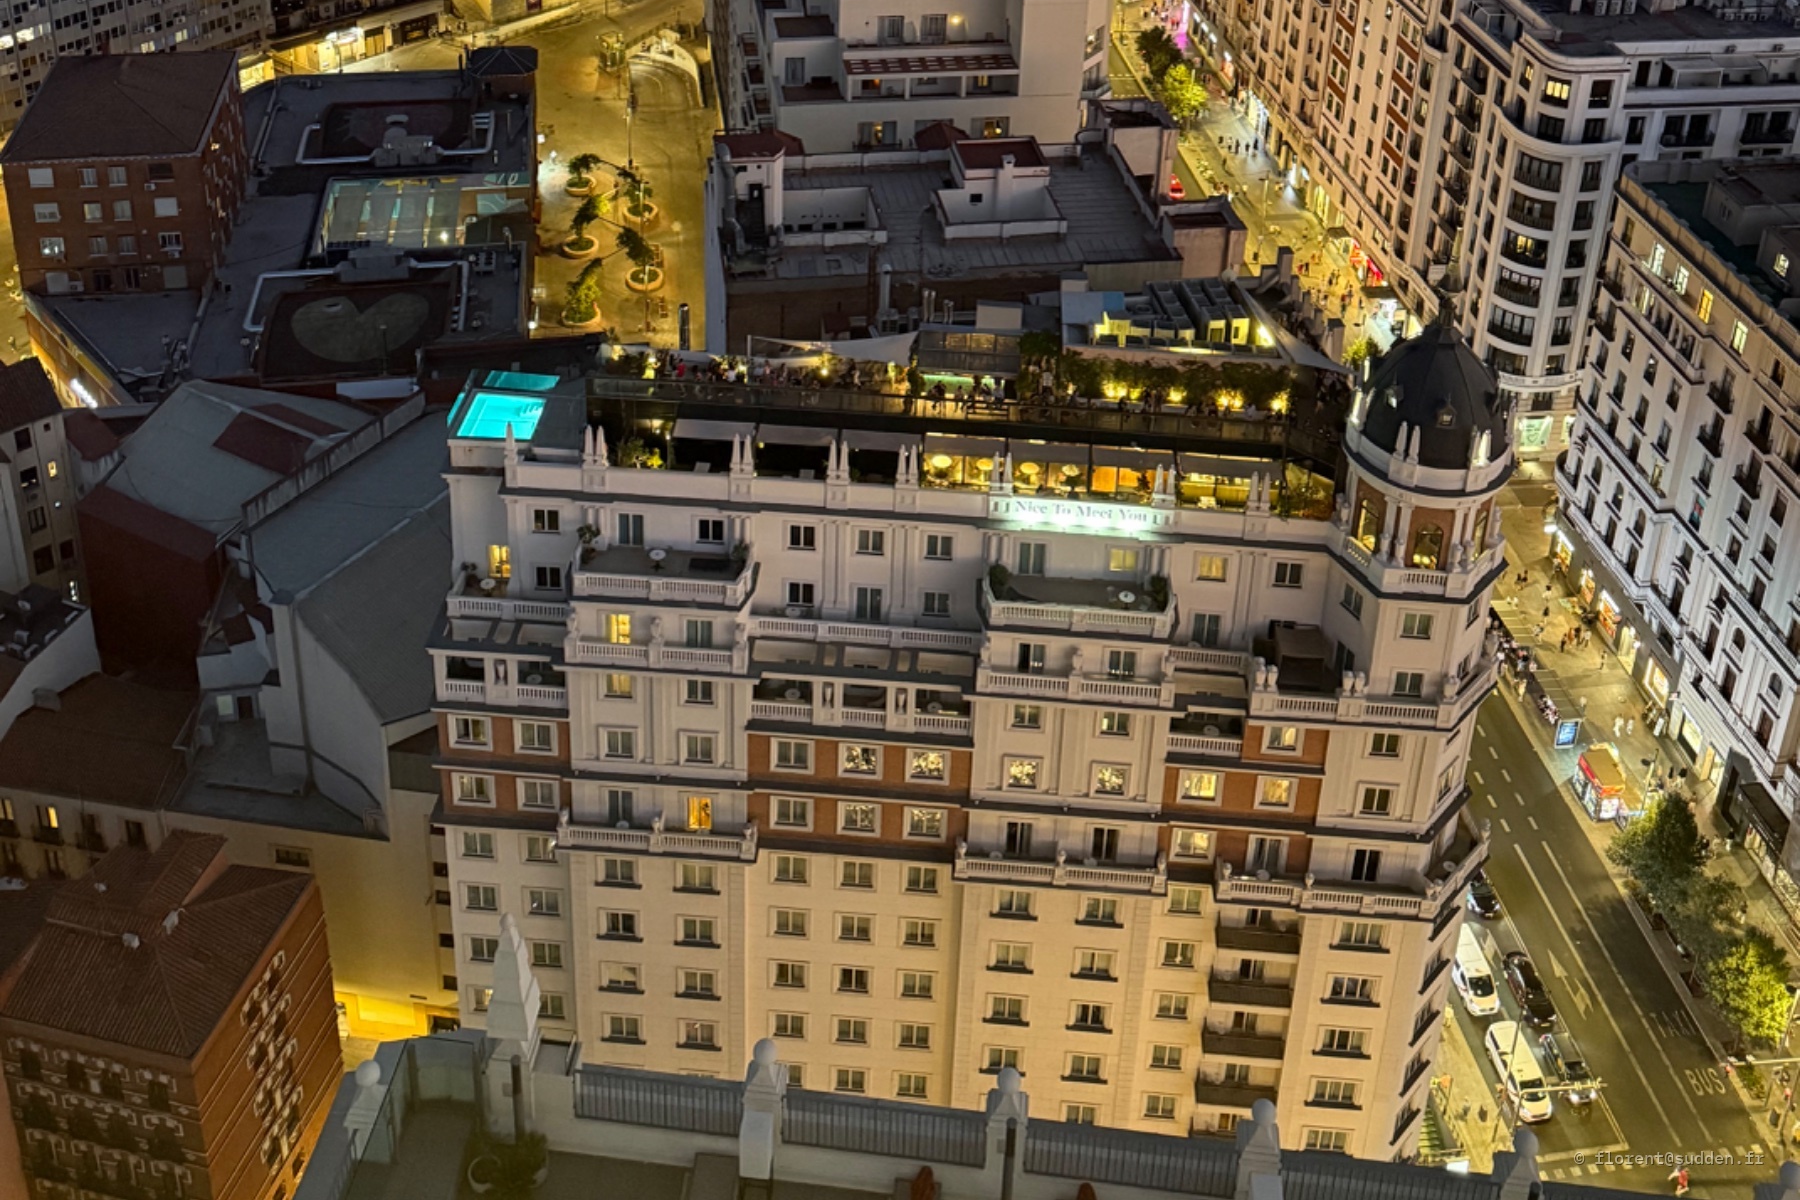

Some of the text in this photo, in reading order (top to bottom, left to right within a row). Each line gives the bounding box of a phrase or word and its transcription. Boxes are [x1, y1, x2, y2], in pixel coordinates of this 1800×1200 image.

[1014, 500, 1148, 523] Nice To Meet You
[1649, 1009, 1697, 1038] TAXI
[1685, 1068, 1726, 1095] BUS
